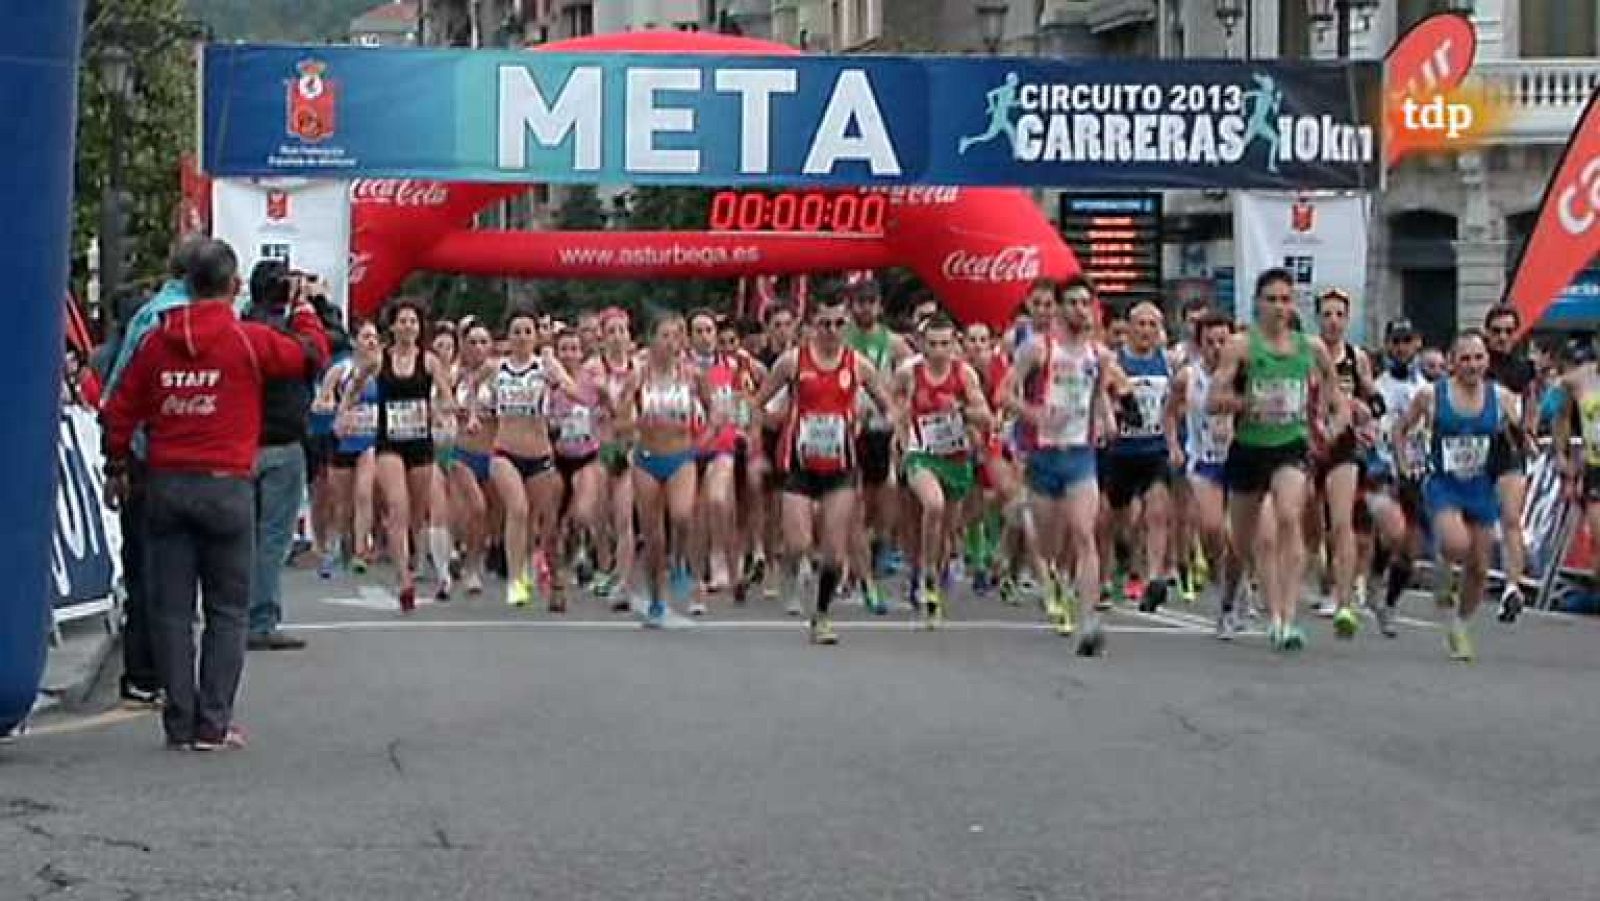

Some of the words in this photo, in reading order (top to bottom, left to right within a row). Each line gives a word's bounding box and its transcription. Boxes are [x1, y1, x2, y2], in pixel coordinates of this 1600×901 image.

[1019, 84, 1163, 111] CIRCUITO
[1170, 83, 1243, 111] 2013
[499, 66, 901, 174] META
[1014, 113, 1247, 163] CARRERAS
[1278, 114, 1373, 162] 10km
[710, 191, 885, 233] 00:00:00
[559, 242, 760, 267] www.asturbega.es
[160, 369, 221, 387] STAFF
